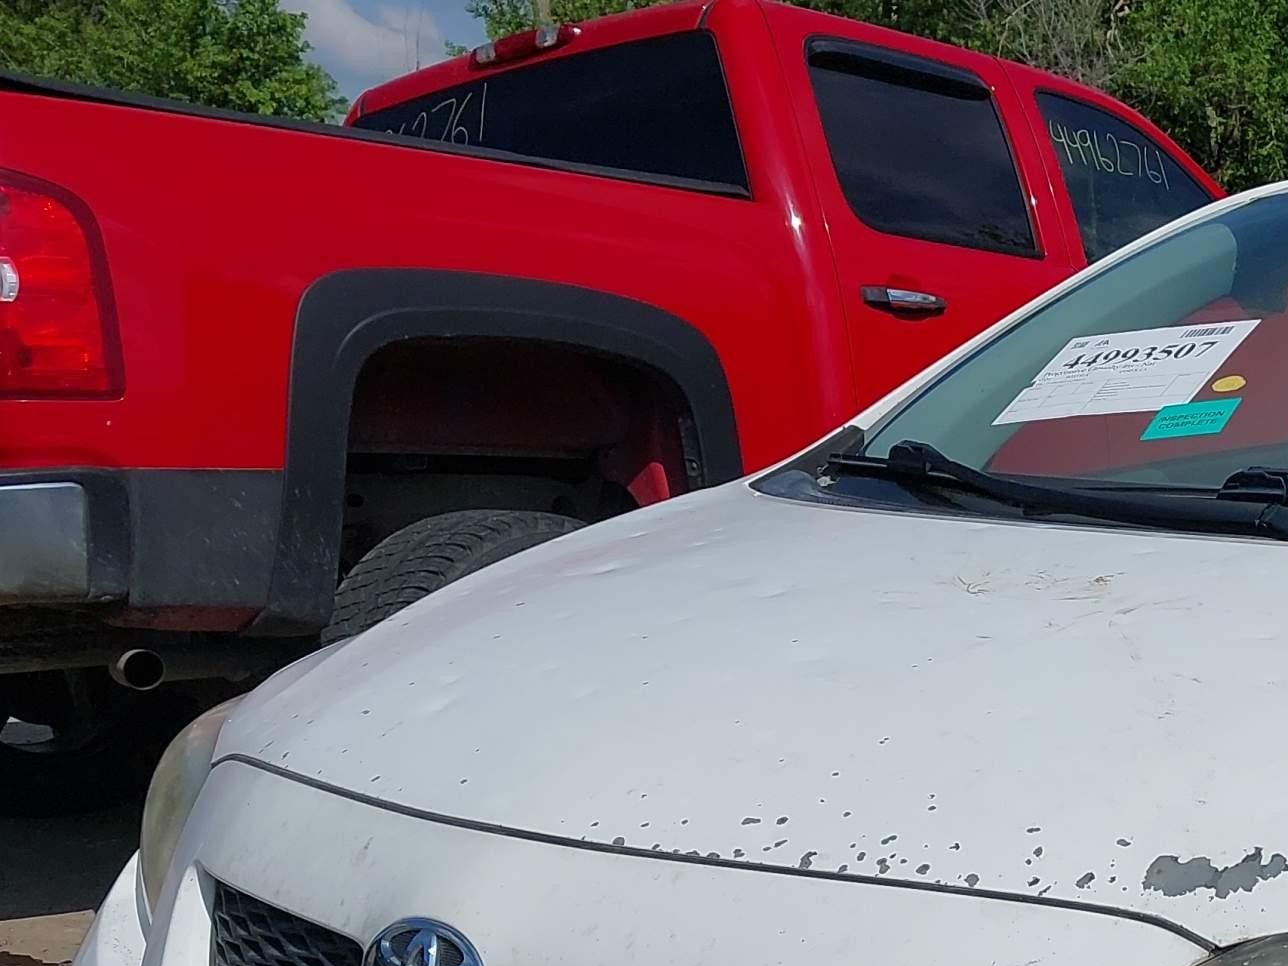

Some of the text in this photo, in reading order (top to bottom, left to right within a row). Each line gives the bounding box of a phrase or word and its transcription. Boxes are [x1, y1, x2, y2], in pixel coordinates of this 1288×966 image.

[385, 82, 487, 145] 2761
[1049, 120, 1169, 190] 44962761
[1063, 341, 1218, 369] 44993507
[1158, 418, 1217, 430] COMPLETE
[1159, 410, 1226, 422] INSPECTION
